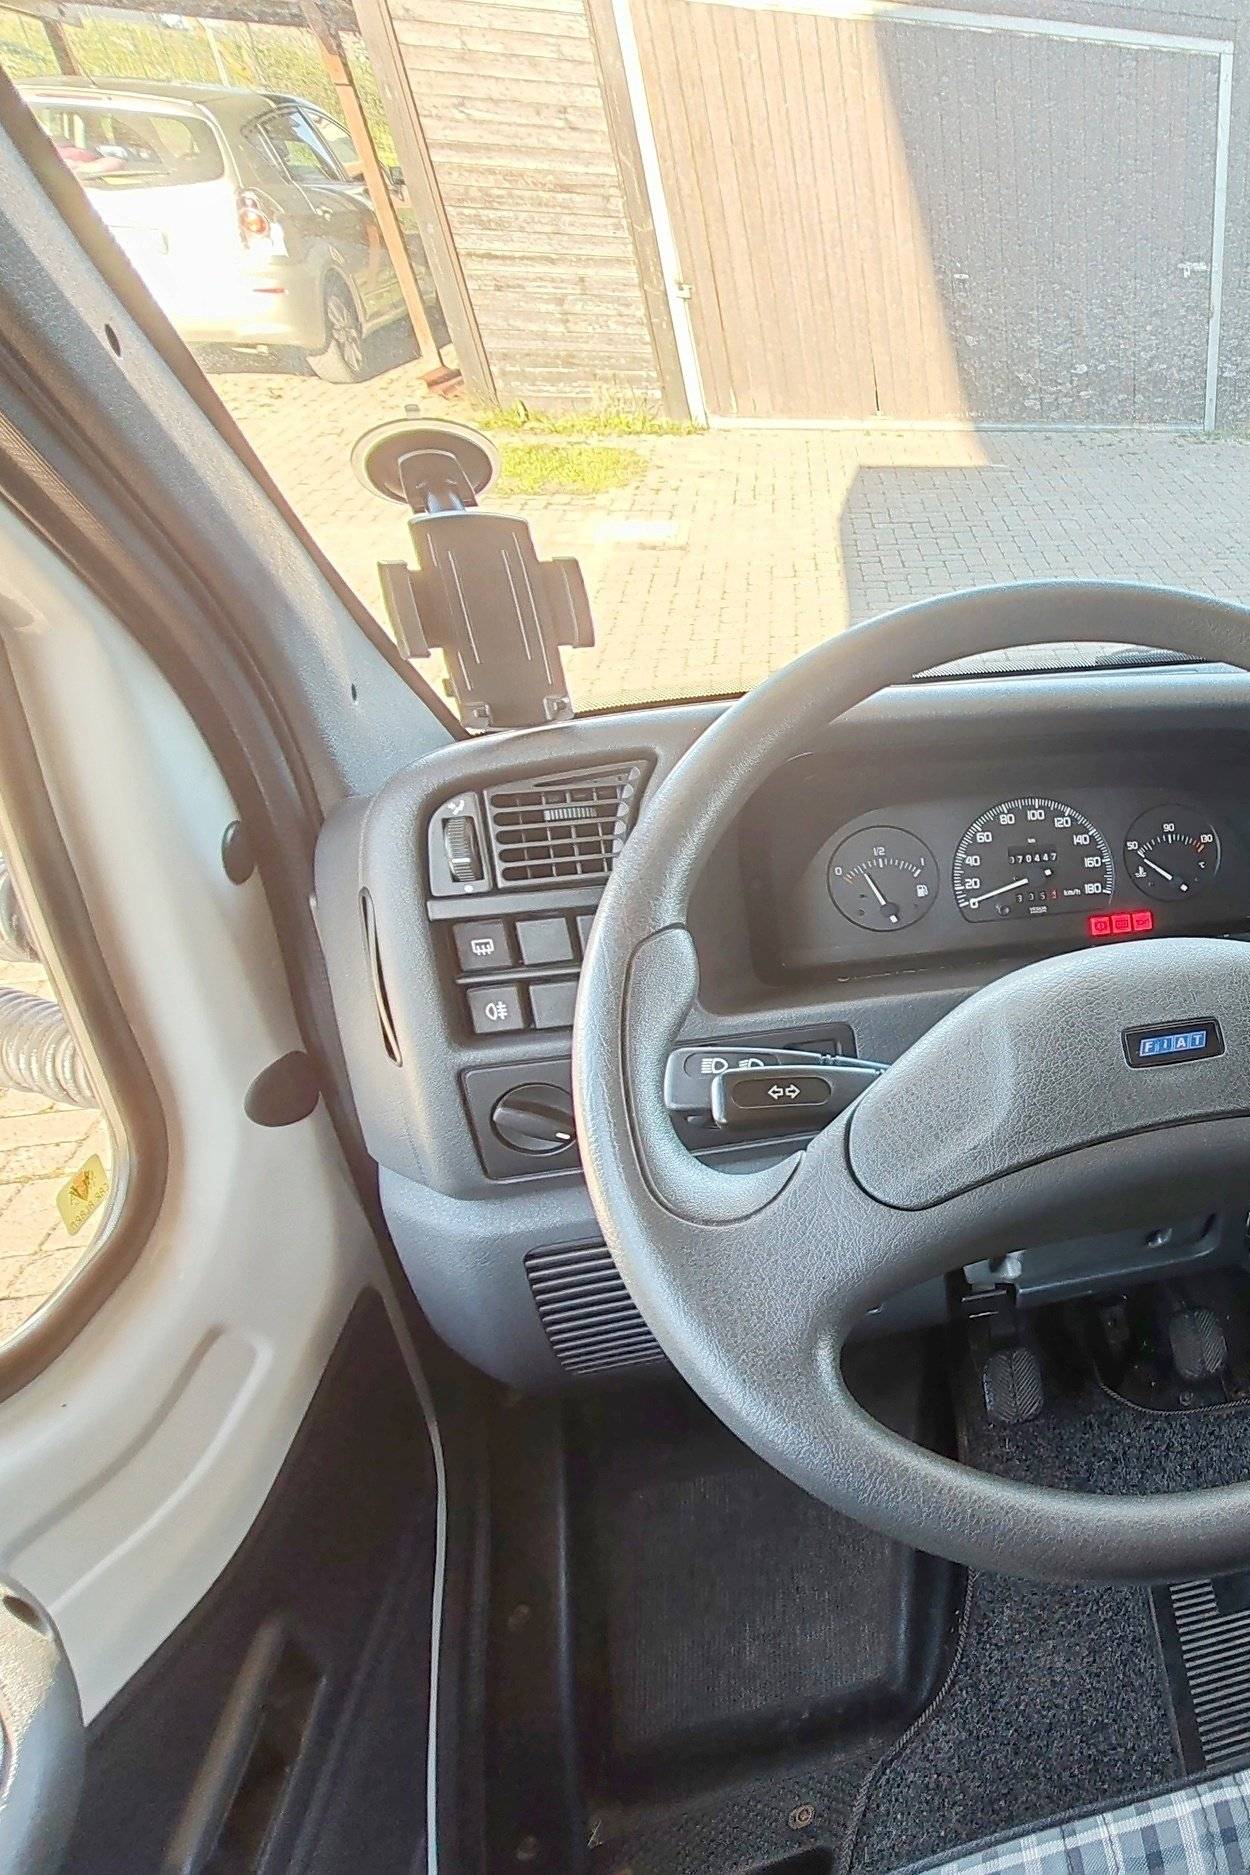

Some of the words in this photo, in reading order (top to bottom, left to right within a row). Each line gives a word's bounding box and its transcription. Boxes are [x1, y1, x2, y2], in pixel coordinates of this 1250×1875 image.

[1000, 814, 1015, 825] 80
[1027, 810, 1045, 820] 100
[1054, 817, 1071, 828] 120
[1163, 823, 1175, 832] 90
[976, 832, 992, 843] 60
[1073, 834, 1090, 845] 140
[1200, 834, 1213, 843] 130
[1127, 841, 1138, 850] 50
[965, 855, 980, 866] 40
[1084, 857, 1101, 868] 160
[834, 867, 842, 876] 0
[965, 878, 980, 889] 20
[1085, 883, 1101, 894] 180
[1064, 889, 1081, 897] km/h
[969, 898, 979, 909] 0
[1143, 1033, 1204, 1054] FIAT
